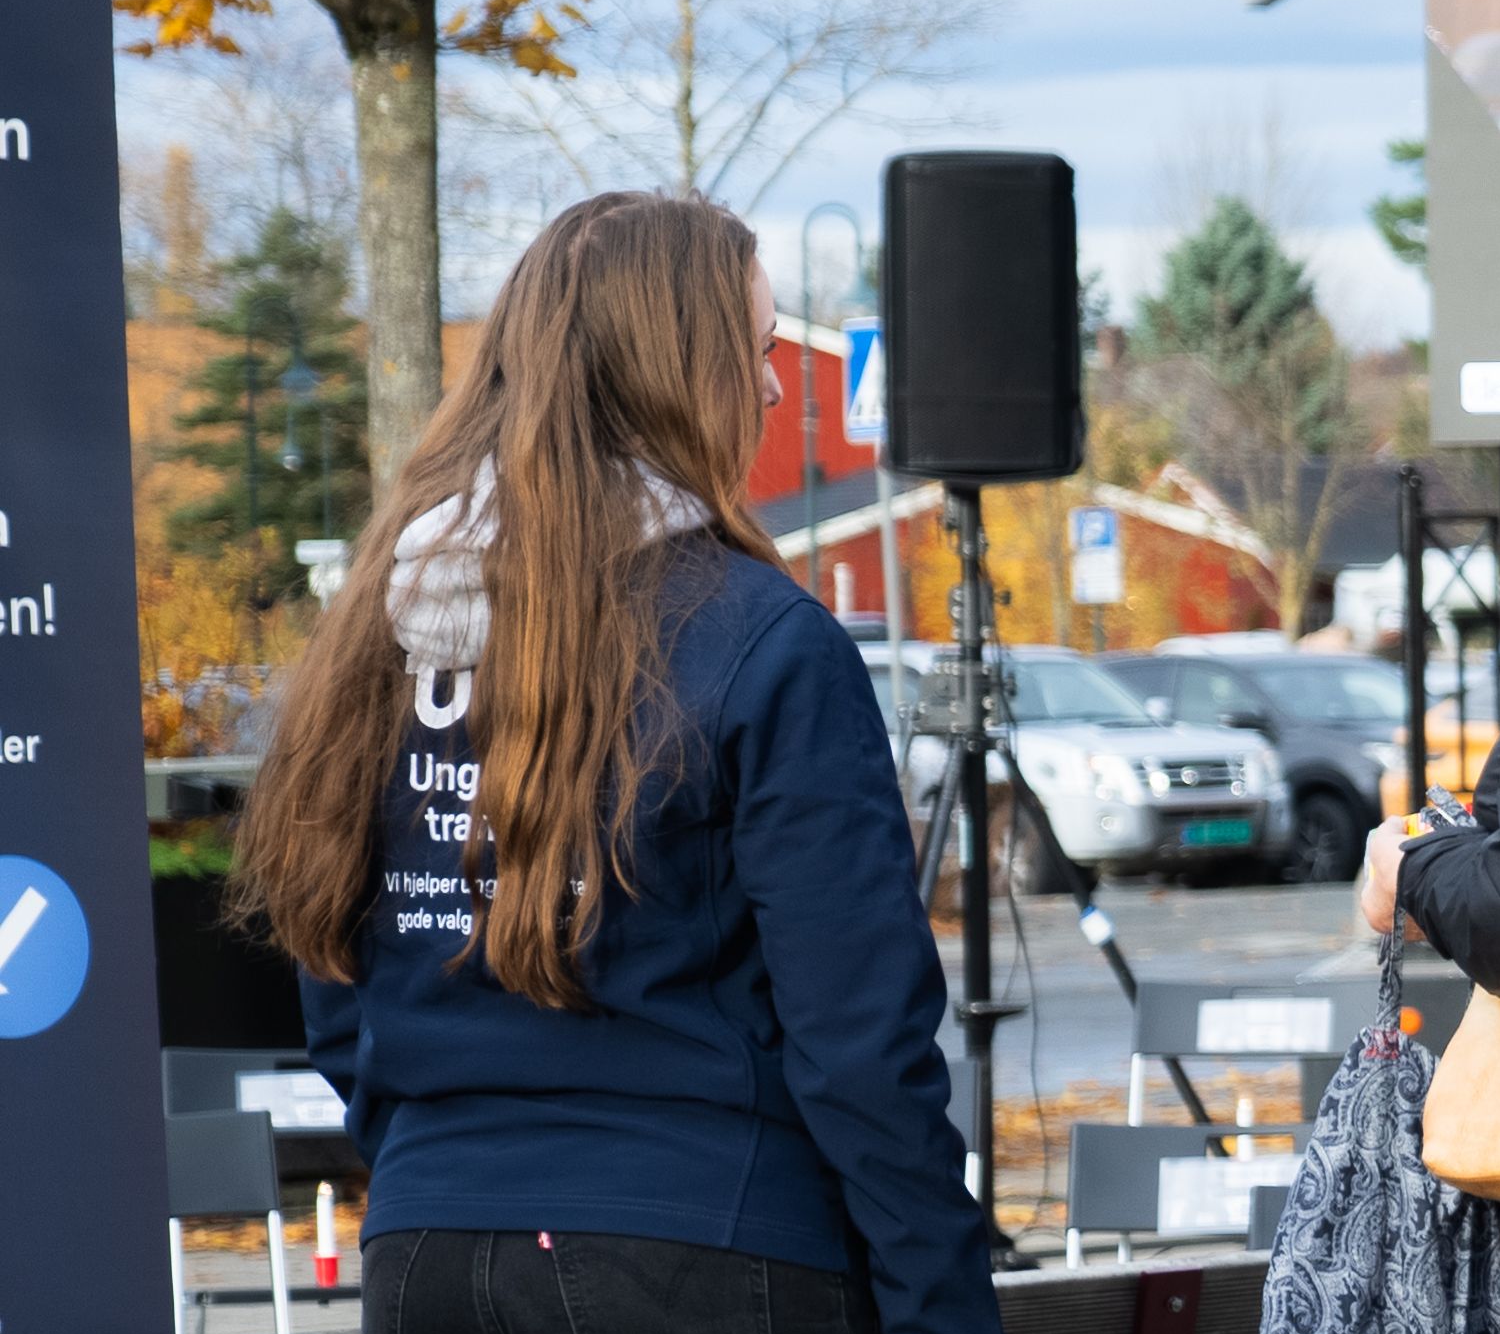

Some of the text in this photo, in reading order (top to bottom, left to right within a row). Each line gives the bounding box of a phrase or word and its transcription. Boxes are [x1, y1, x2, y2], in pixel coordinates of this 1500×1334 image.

[408, 752, 480, 802] Ung
[385, 872, 400, 894] Vi
[402, 871, 458, 899] hjelper
[397, 908, 472, 936] gode valg
